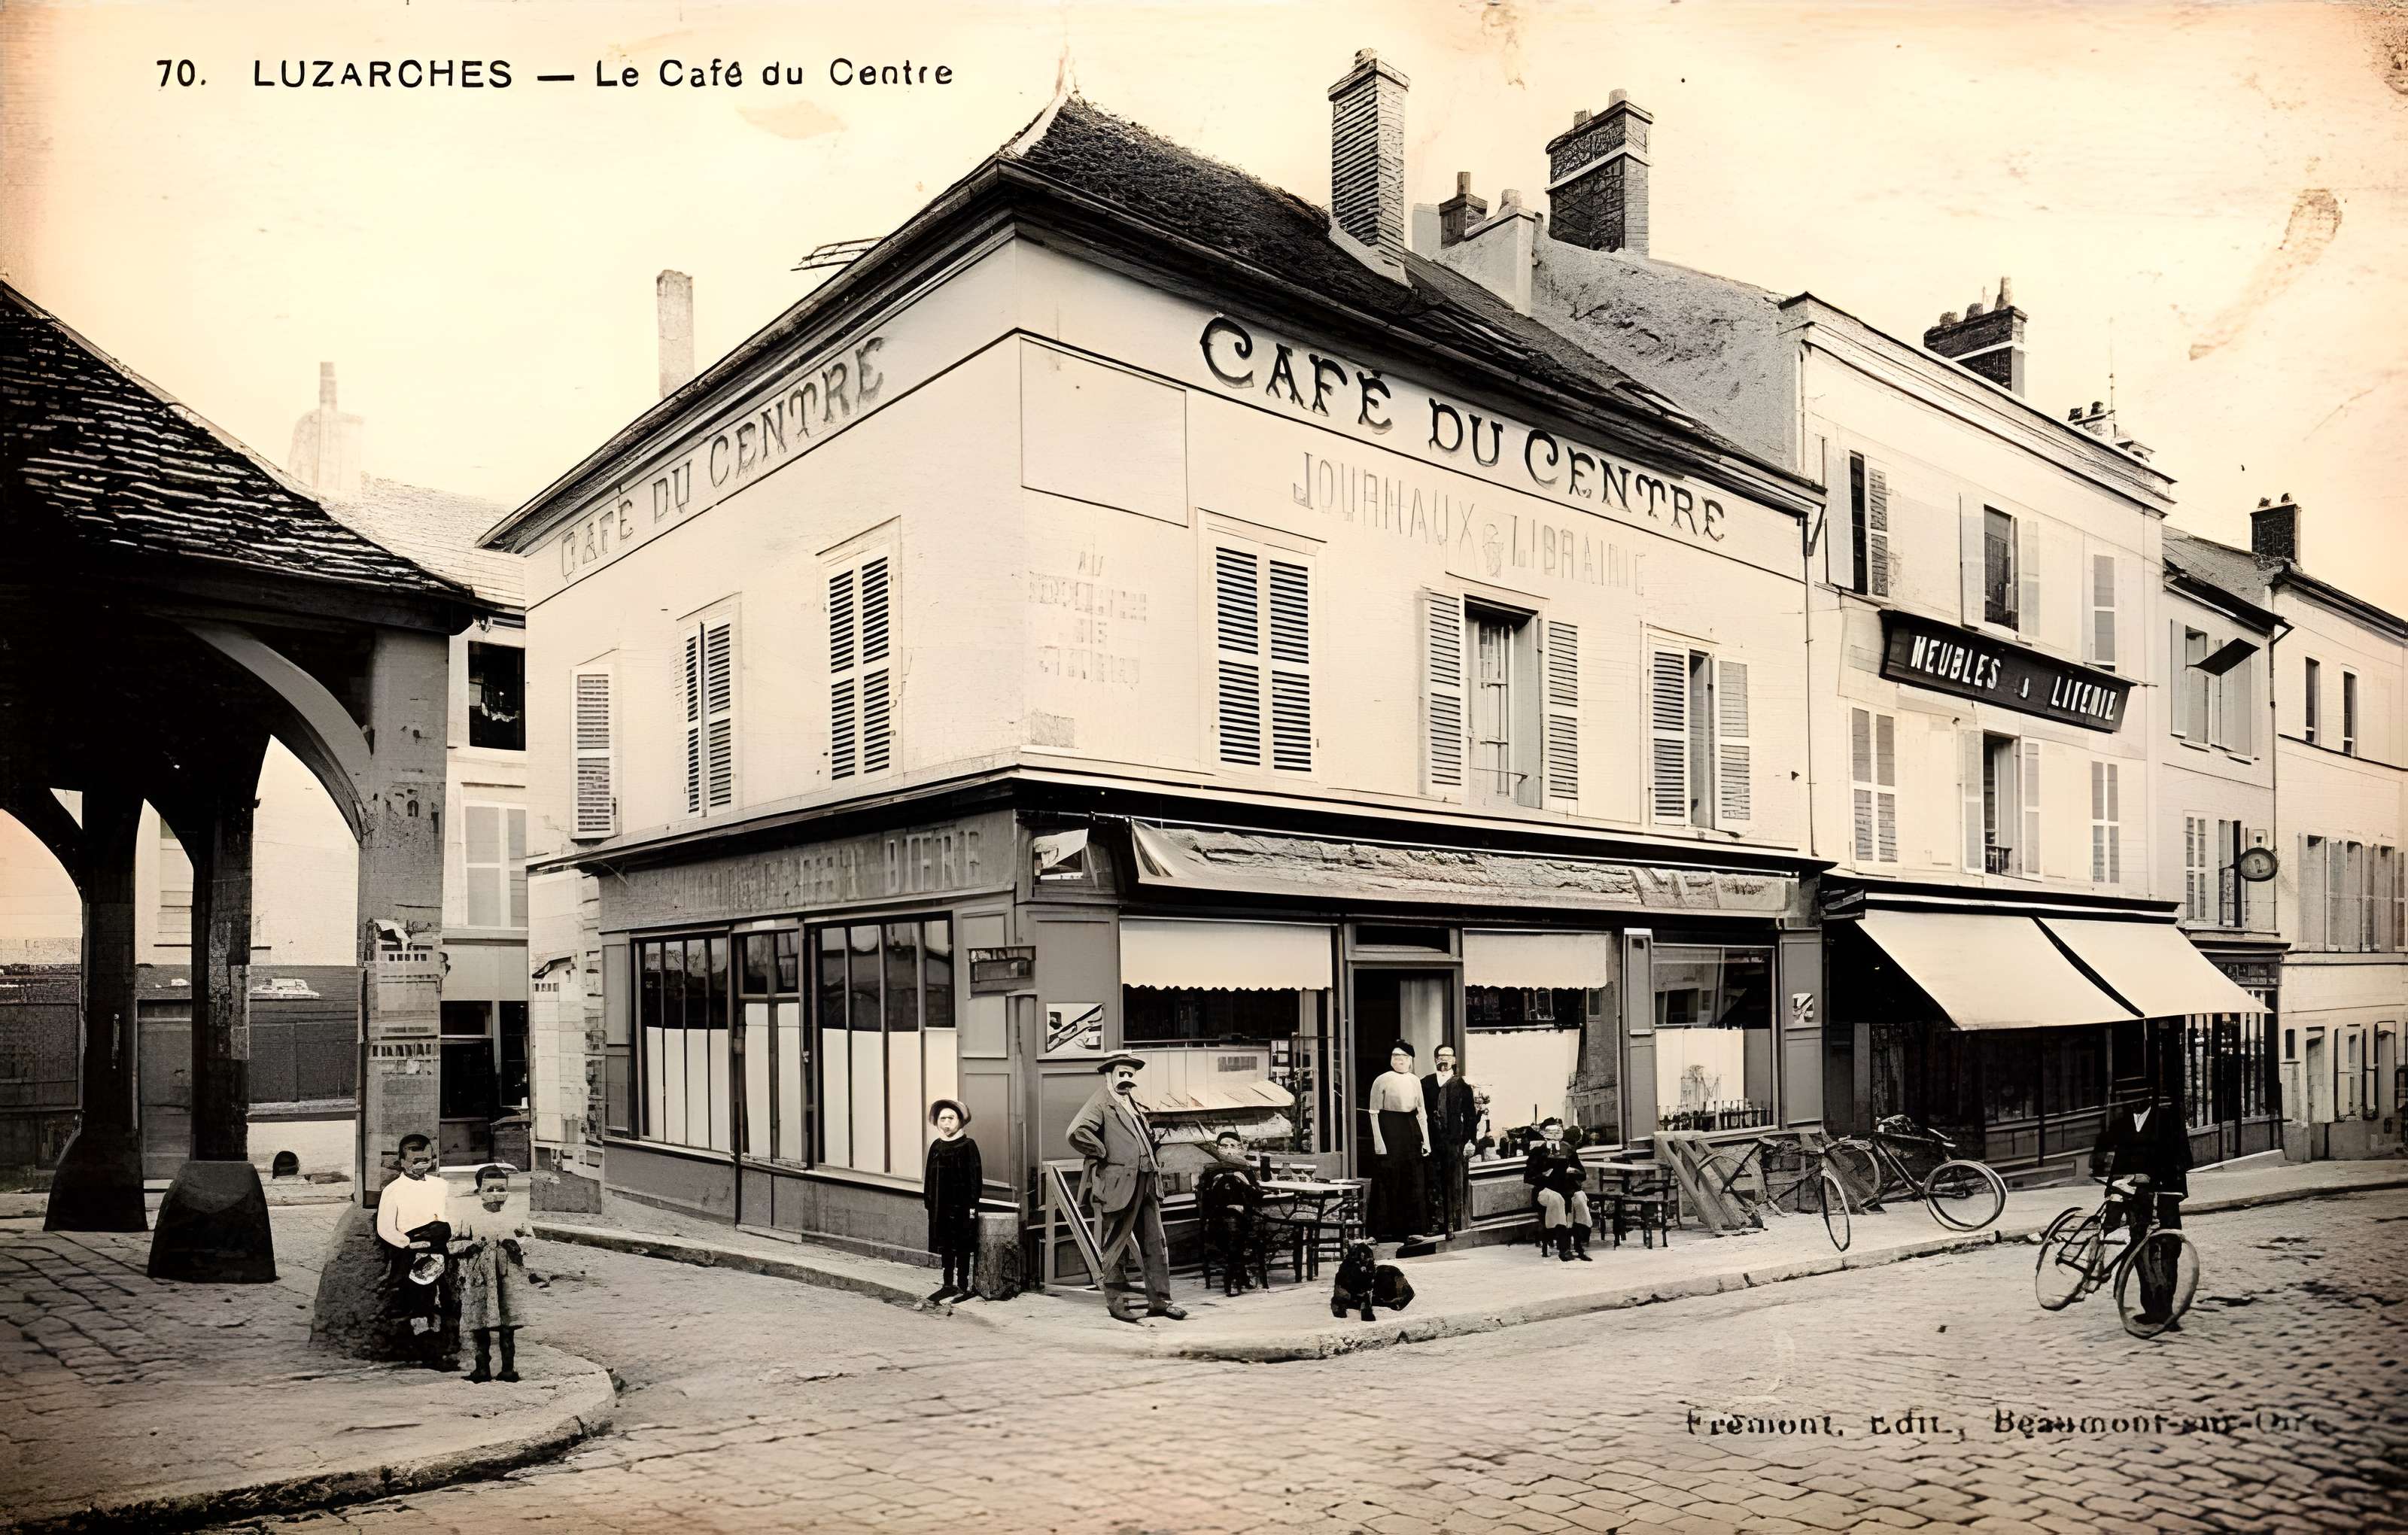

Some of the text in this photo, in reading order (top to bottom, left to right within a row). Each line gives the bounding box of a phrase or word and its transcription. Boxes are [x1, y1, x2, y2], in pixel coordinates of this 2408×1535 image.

[652, 458, 693, 524] DU
[709, 336, 886, 489] CENTRE
[1428, 397, 1504, 468] DU
[1524, 428, 1726, 543] CENTRE
